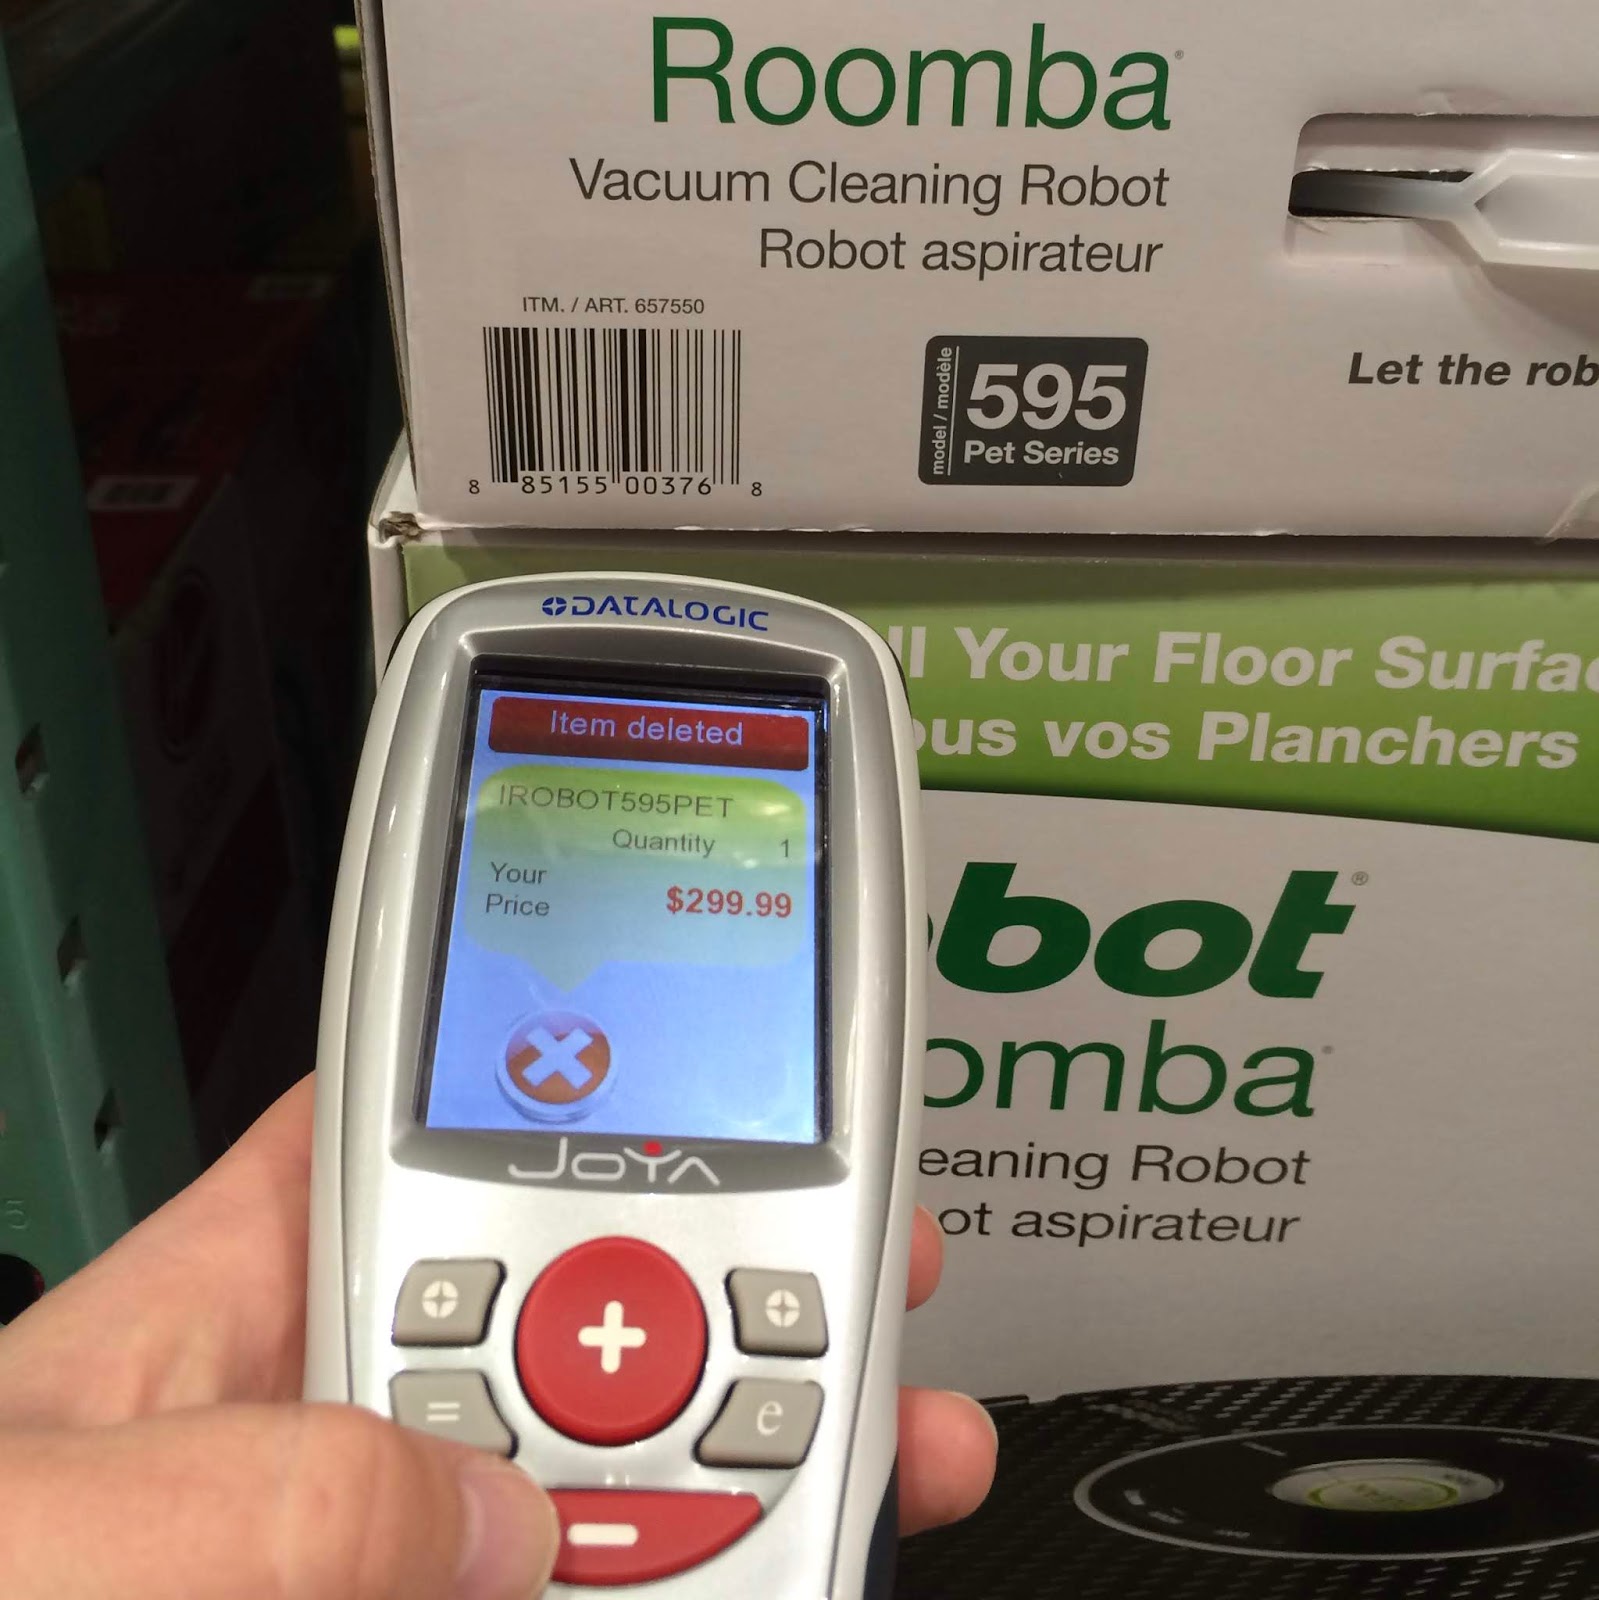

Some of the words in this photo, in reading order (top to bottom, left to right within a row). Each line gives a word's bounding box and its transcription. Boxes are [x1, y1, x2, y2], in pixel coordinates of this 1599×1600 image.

[652, 16, 1171, 131] Roomba
[569, 158, 769, 202] Vacuum
[788, 160, 1001, 217] Cleaning
[1020, 164, 1169, 208] Robot
[759, 228, 905, 270] Robot
[921, 232, 1163, 281] aspirateur
[522, 297, 565, 313] ITM.
[584, 298, 628, 314] ART.
[634, 298, 705, 314] 657550
[936, 346, 953, 410] modèle
[1348, 352, 1424, 385] Let
[1438, 353, 1512, 386] the
[1526, 354, 1599, 387] rob
[966, 362, 1128, 431] 595
[931, 425, 947, 475] model
[963, 439, 1016, 464] Pet
[1023, 439, 1120, 465] Series
[468, 479, 481, 495] 8
[521, 476, 608, 495] 85155
[625, 476, 712, 496] 00376
[751, 481, 763, 497] 8
[571, 596, 769, 631] DATALOGIC
[953, 626, 1129, 683] Your
[1153, 631, 1353, 688] Floor
[550, 709, 616, 738] Item
[627, 716, 745, 746] deleted
[1043, 720, 1171, 760] vos
[1198, 711, 1579, 769] Planchers
[500, 783, 735, 820] IROBOT595PET
[612, 828, 716, 857] Quantity
[779, 838, 791, 858] 1
[490, 861, 547, 885] Your
[485, 893, 550, 918] Price
[666, 885, 793, 919] $299.99
[926, 862, 1356, 999] bot
[1131, 1143, 1311, 1186] Robot
[1011, 1204, 1301, 1248] aspirateur
